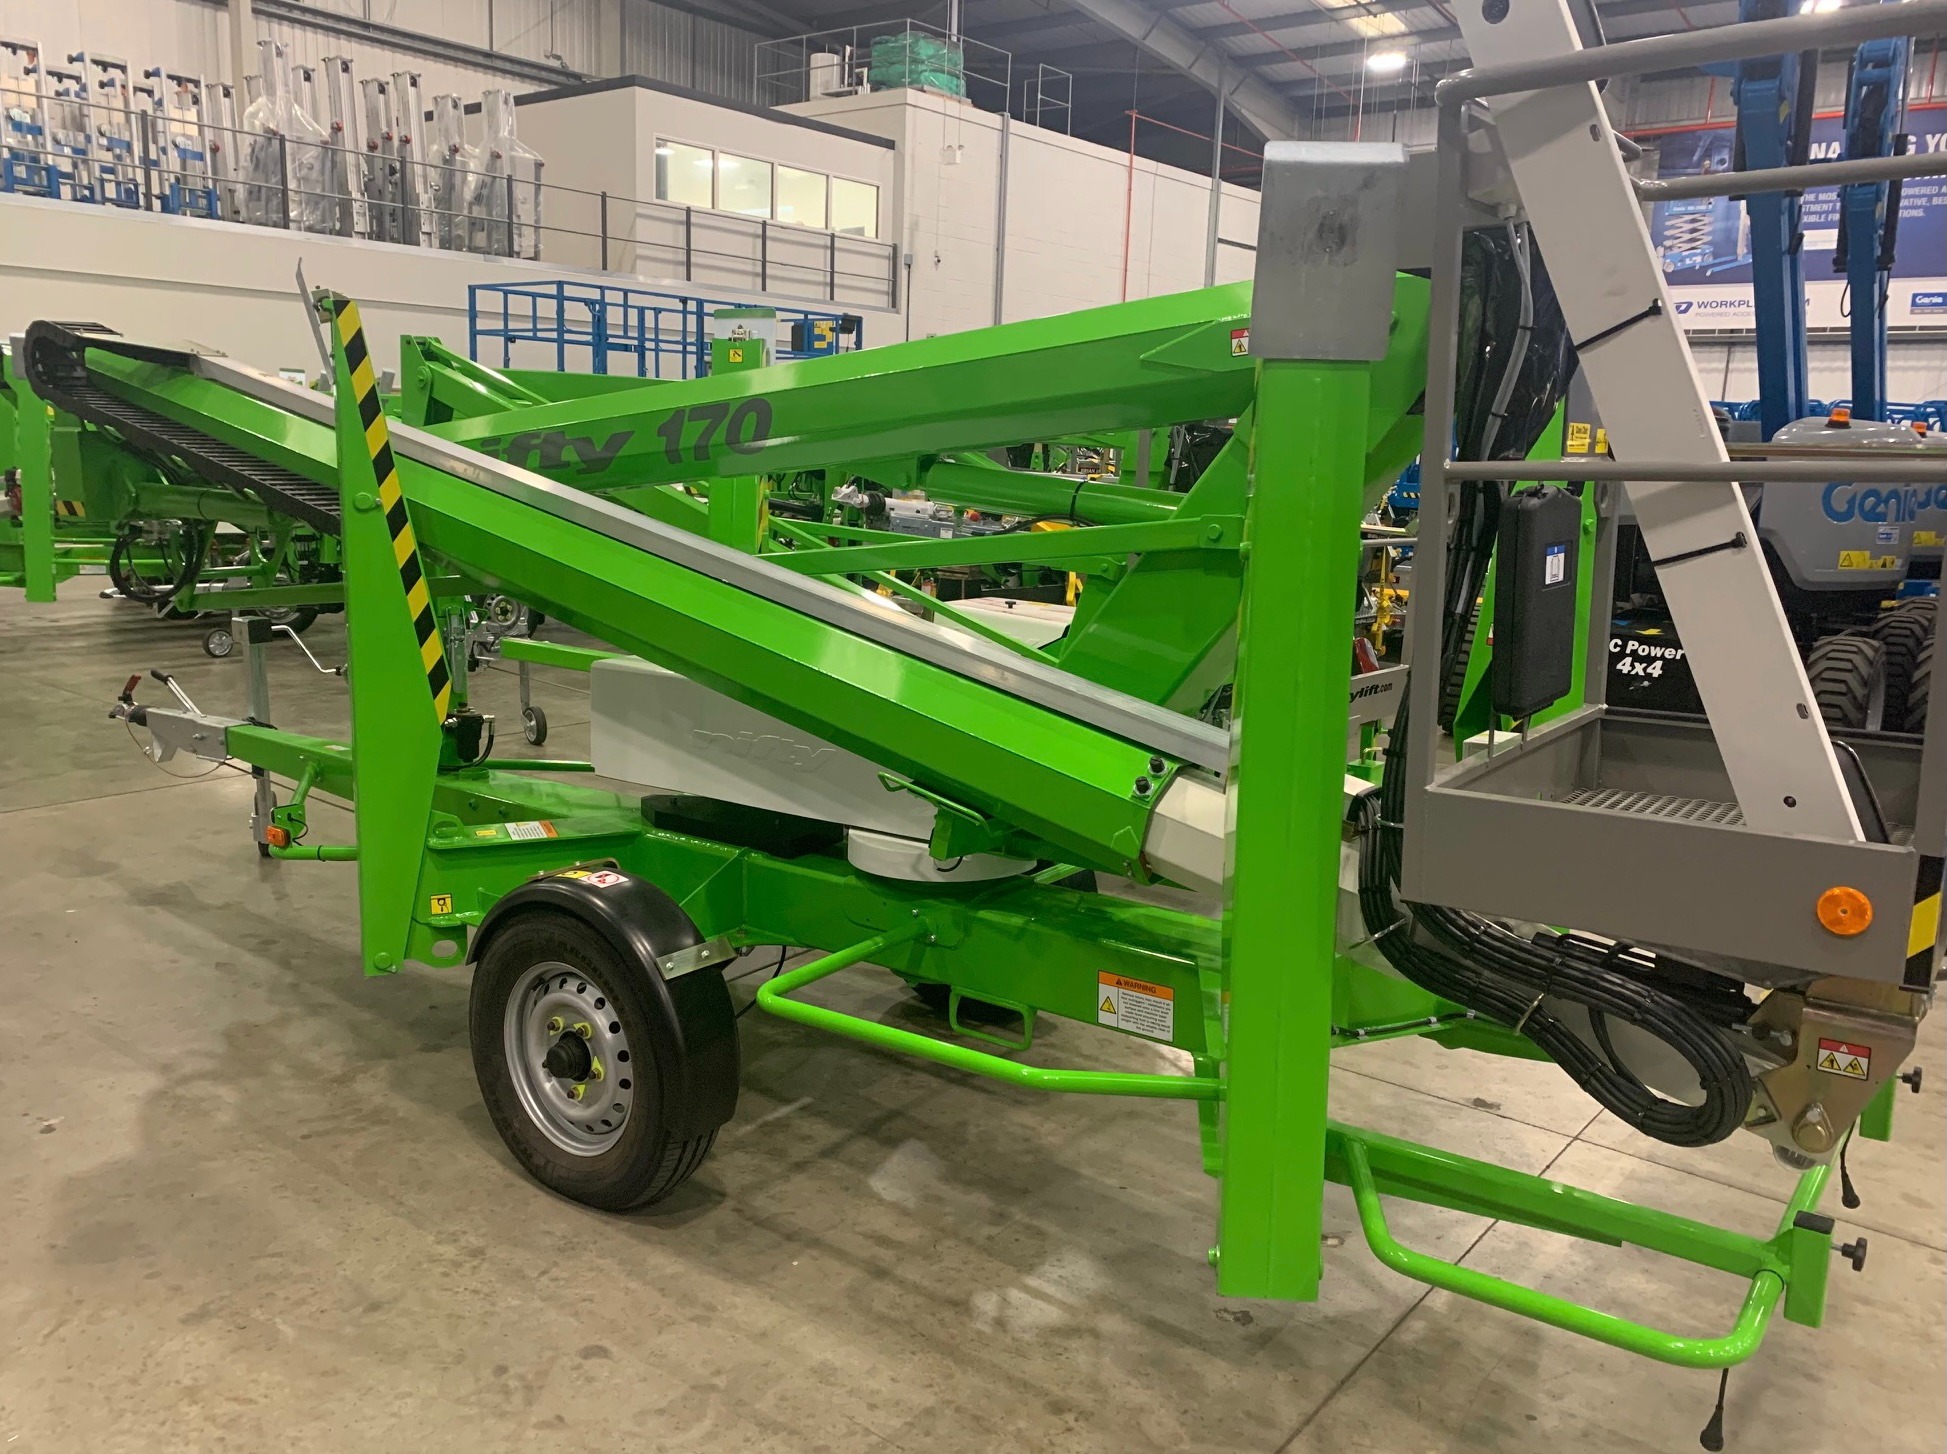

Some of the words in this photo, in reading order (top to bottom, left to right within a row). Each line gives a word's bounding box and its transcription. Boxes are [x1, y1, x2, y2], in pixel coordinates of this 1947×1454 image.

[1818, 192, 1838, 201] MOS
[1902, 186, 1939, 196] OWERED
[480, 430, 635, 474] ifty
[657, 398, 773, 464] 170
[1609, 638, 1623, 653] C
[1625, 640, 1685, 660] Power
[1616, 656, 1663, 678] 4x4
[1349, 682, 1393, 704] ylift.com
[1124, 980, 1157, 994] WARNING
